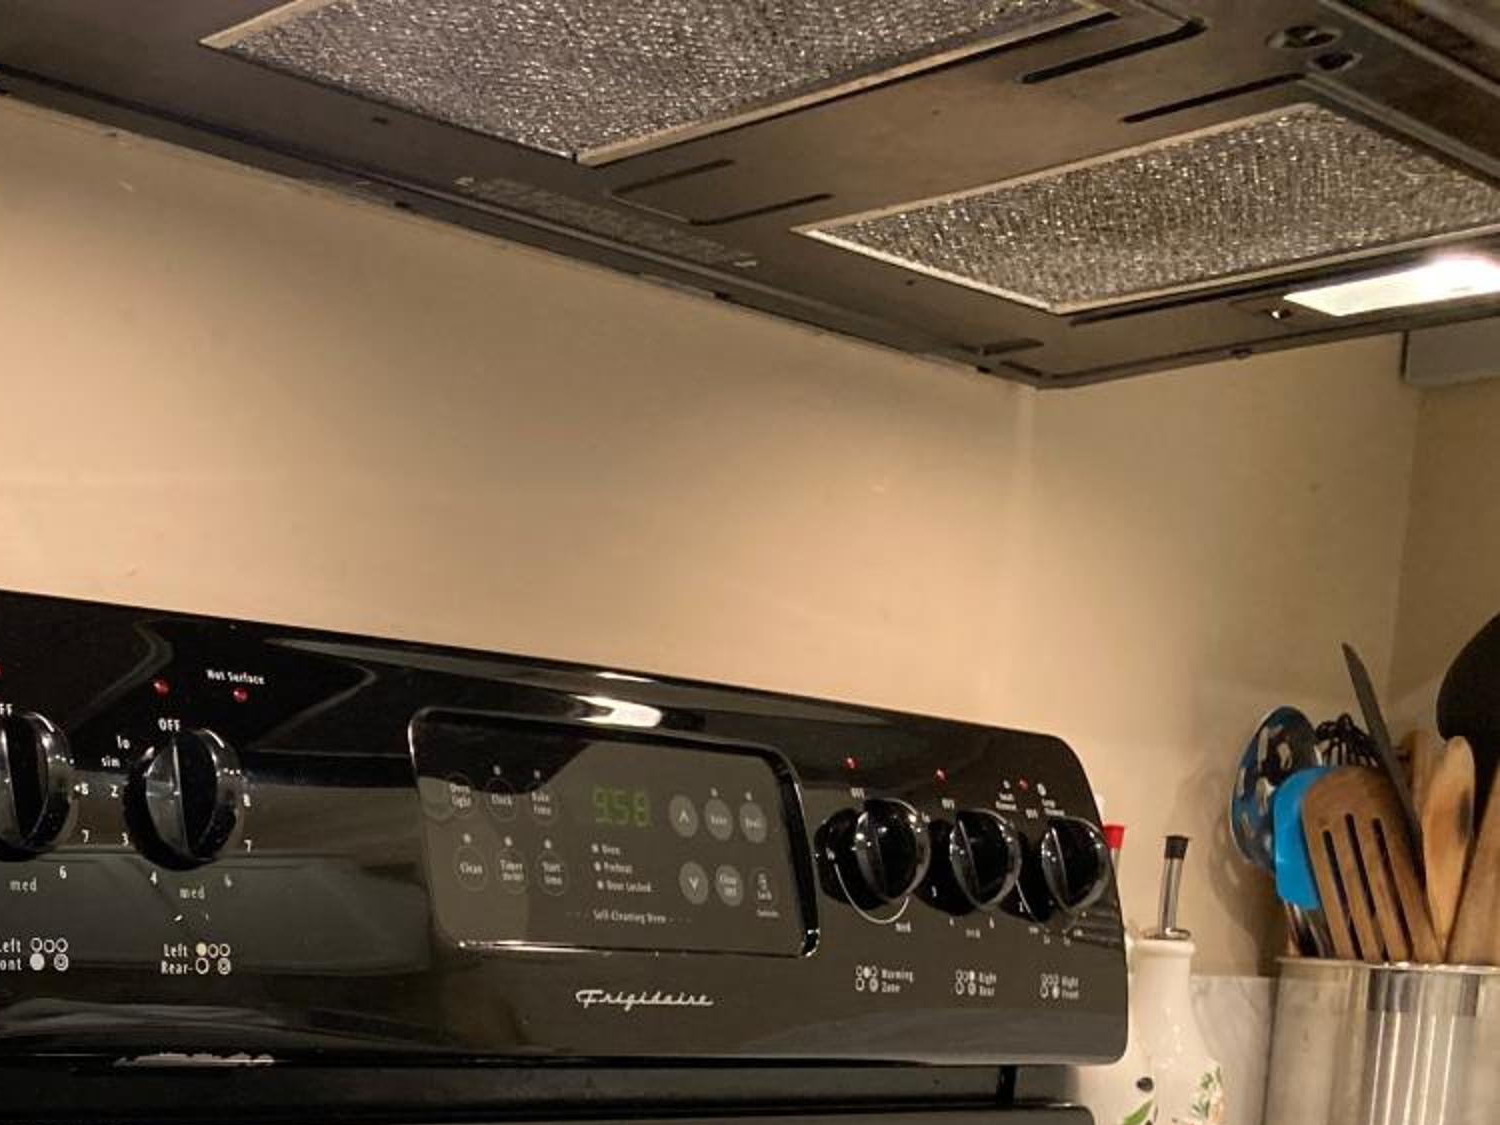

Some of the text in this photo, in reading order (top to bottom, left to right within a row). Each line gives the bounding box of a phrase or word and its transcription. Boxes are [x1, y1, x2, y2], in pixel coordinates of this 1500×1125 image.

[158, 718, 181, 732] OFF
[101, 755, 121, 768] sim
[110, 785, 119, 798] 2
[81, 829, 90, 843] 7
[121, 832, 129, 847] 3
[244, 839, 252, 853] 7
[58, 865, 67, 880] 6
[150, 871, 157, 885] 4
[9, 878, 37, 892] med
[180, 885, 205, 900] med
[163, 943, 188, 957] Left
[160, 960, 188, 975] Rear
[881, 969, 914, 984] Warming
[575, 989, 714, 1012] Frigidaire
